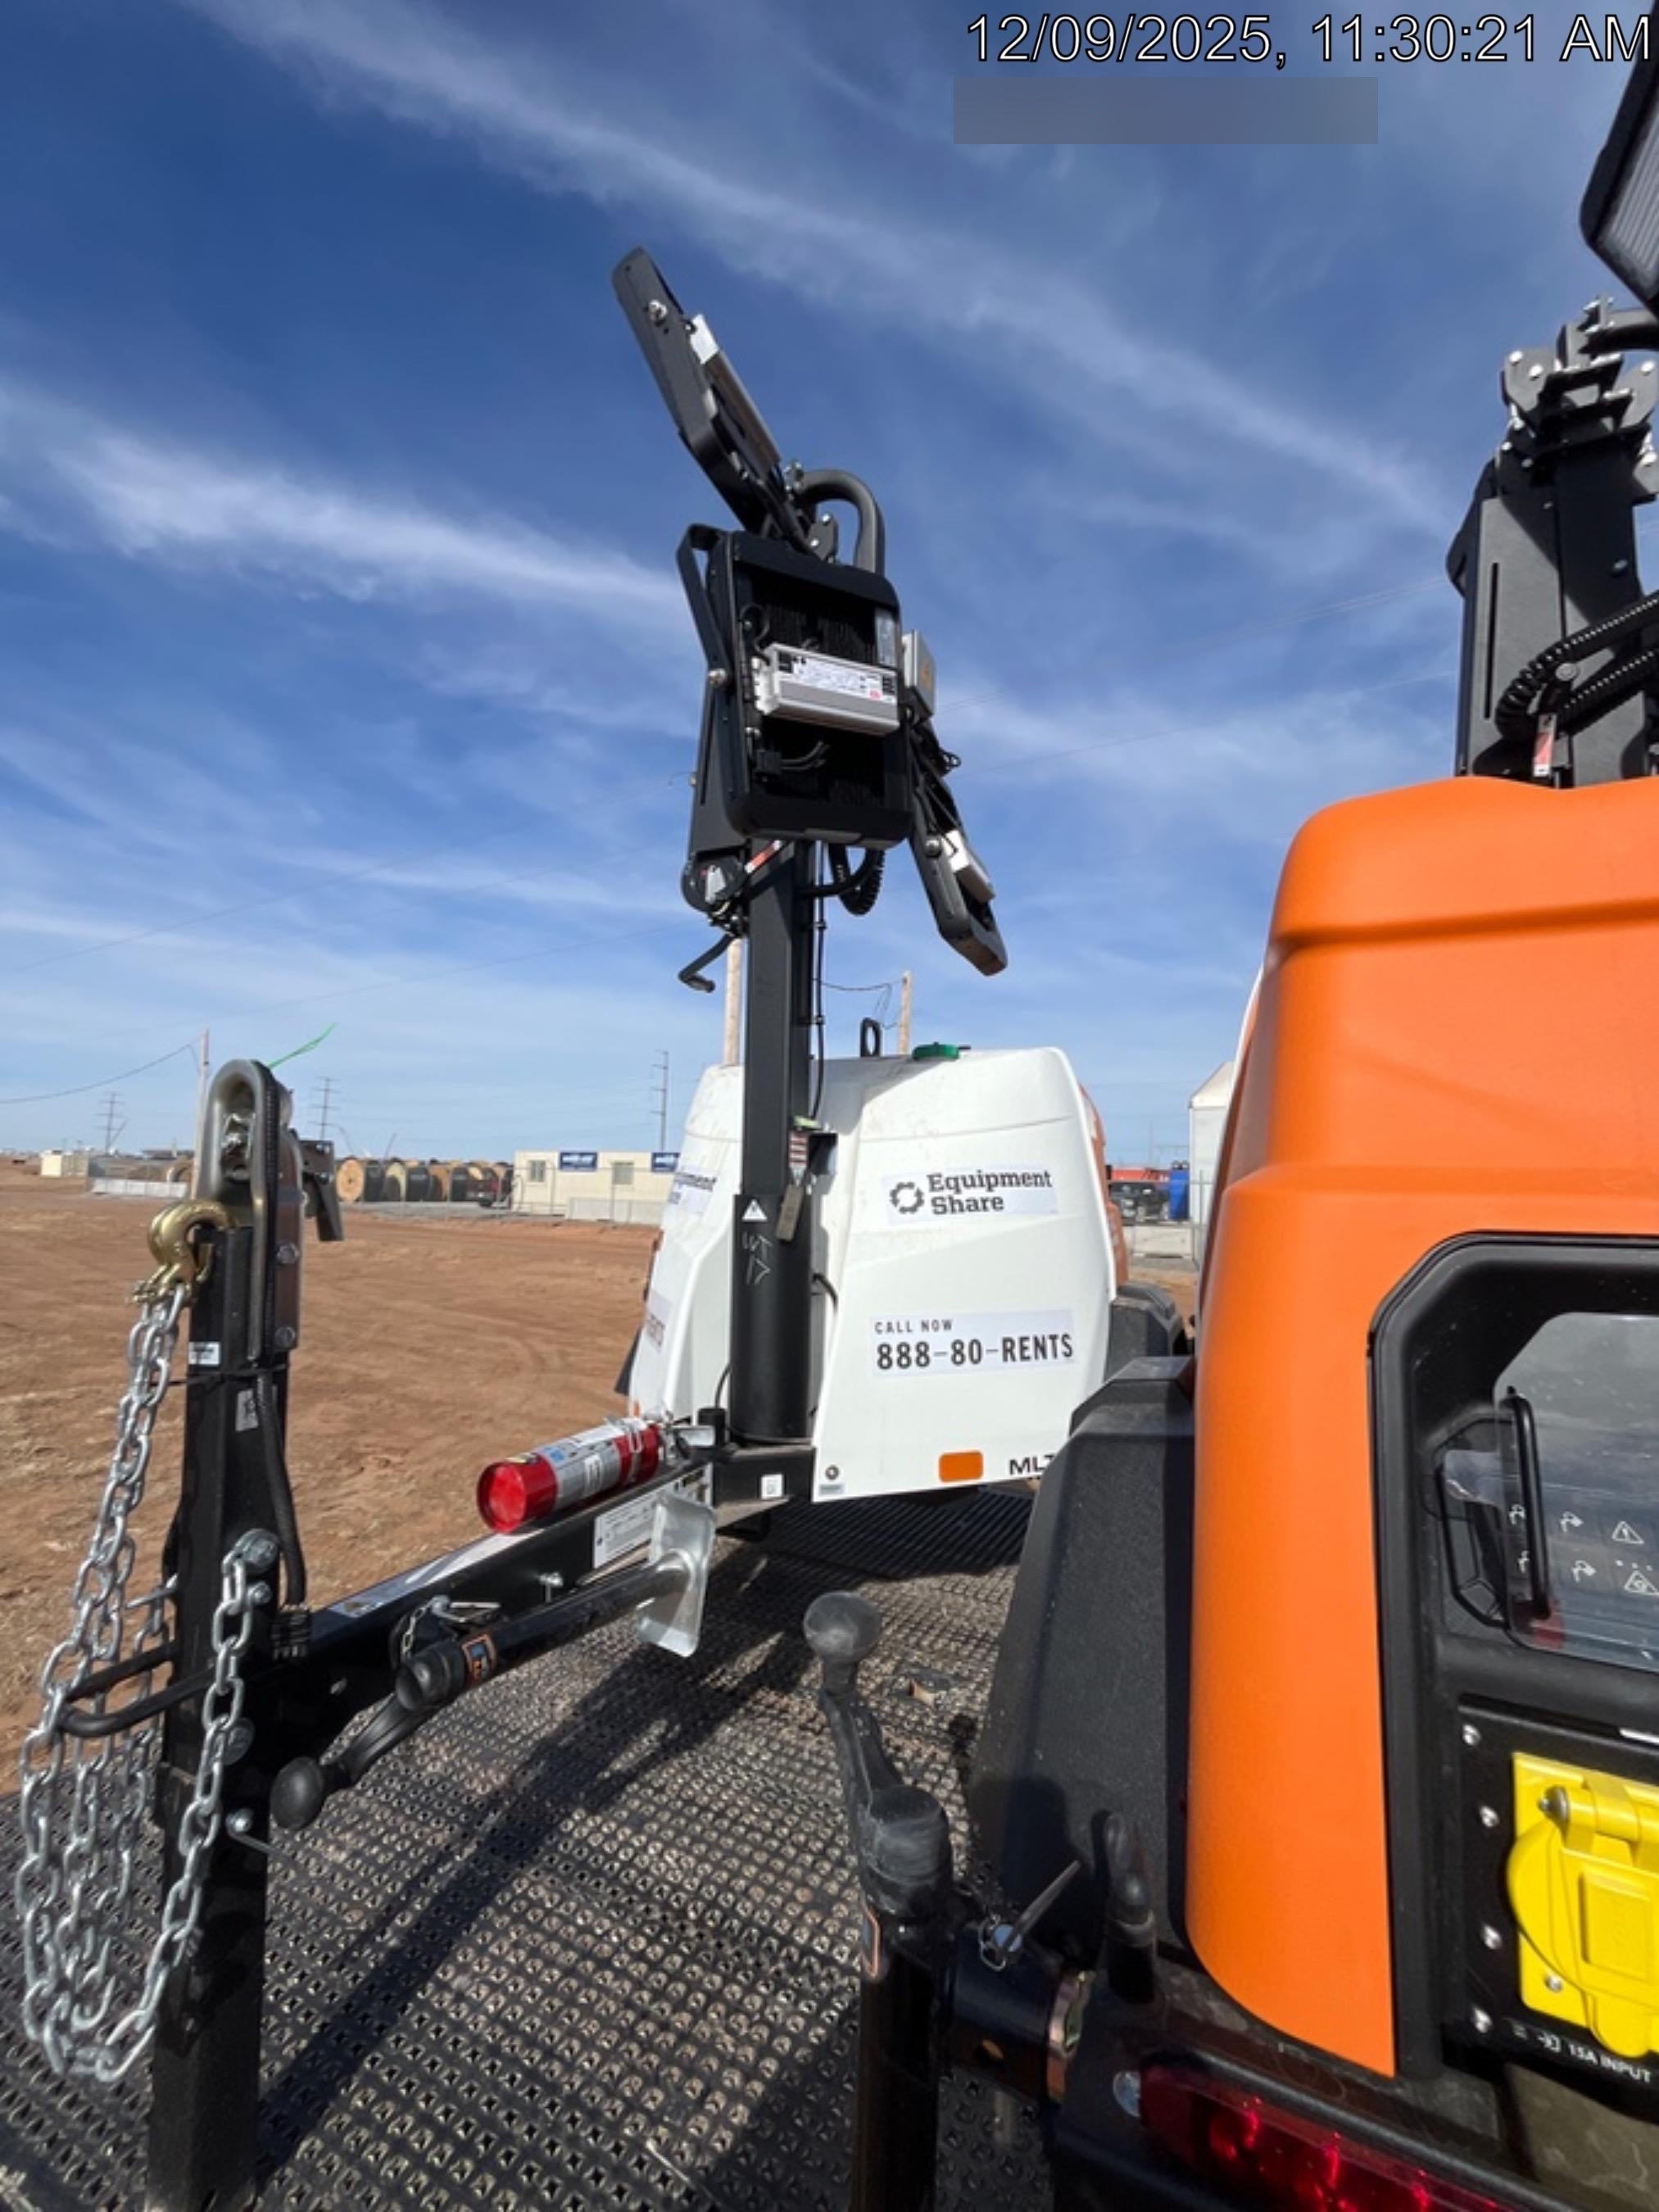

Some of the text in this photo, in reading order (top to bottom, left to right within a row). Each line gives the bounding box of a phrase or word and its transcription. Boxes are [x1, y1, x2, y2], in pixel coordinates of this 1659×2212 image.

[927, 1169, 1052, 1193] Equipment
[930, 1195, 1004, 1215] Share
[874, 1318, 954, 1335] CALL NOW
[877, 1333, 1073, 1370] 888-80-RENTS
[1600, 2055, 1651, 2083] INPUT
